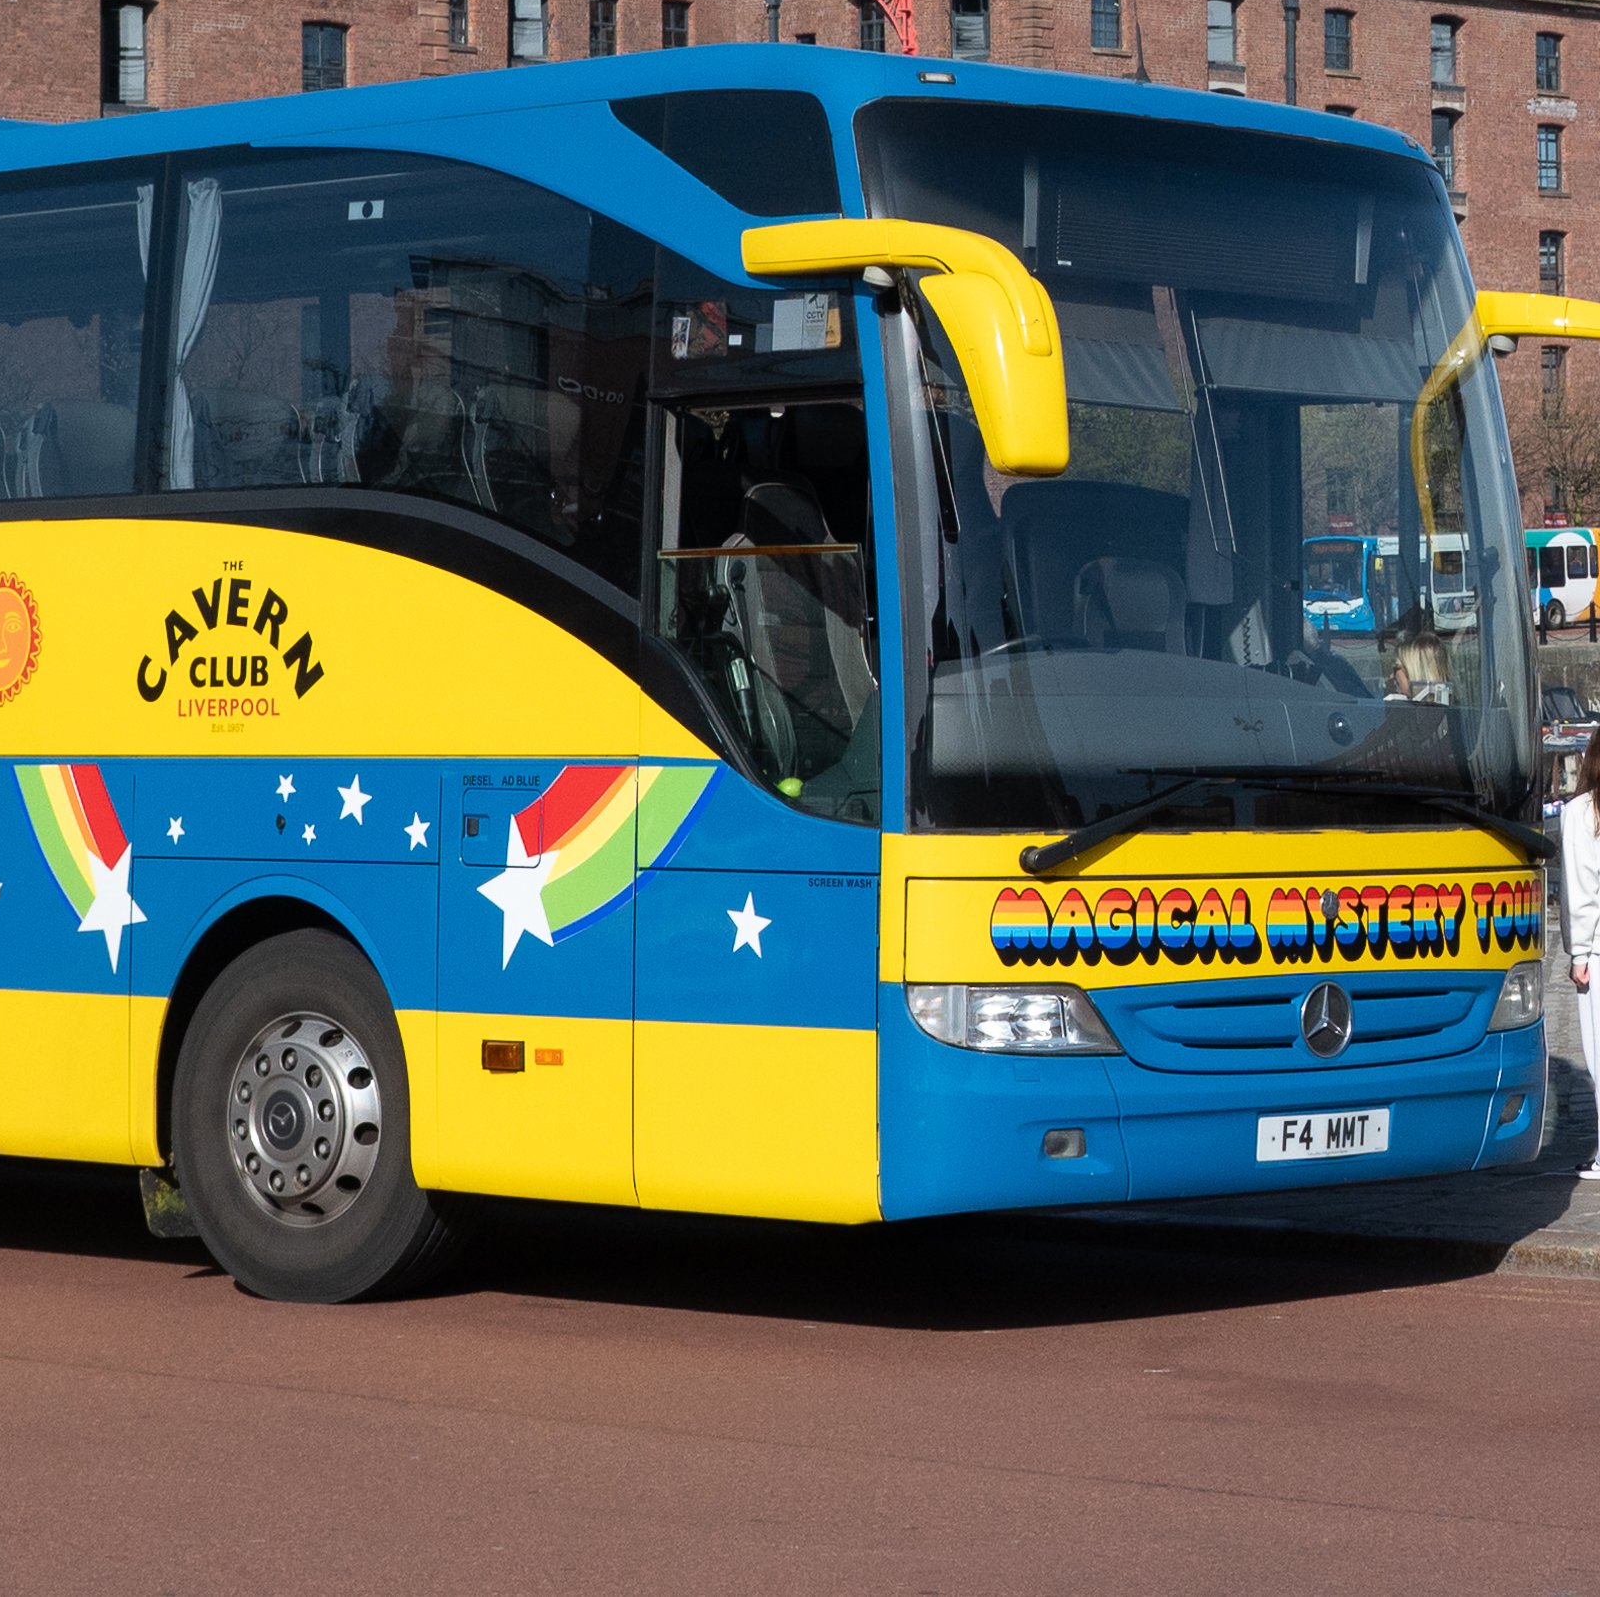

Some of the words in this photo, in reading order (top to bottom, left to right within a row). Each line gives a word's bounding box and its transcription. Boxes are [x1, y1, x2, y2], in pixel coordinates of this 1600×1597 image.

[806, 311, 825, 320] CCTV
[223, 560, 244, 571] THE
[137, 578, 325, 703] CAVERN
[189, 656, 269, 688] CLUB
[177, 698, 280, 717] LIVERPOOL
[227, 722, 245, 733] 1957
[462, 775, 494, 786] DIESEL
[516, 775, 540, 786] BLUE
[808, 878, 844, 888] SCREEN
[846, 878, 872, 888] WASH
[990, 888, 1261, 967] MAGICAL
[1266, 884, 1466, 963] MYSTERY
[1282, 1119, 1313, 1152] F4
[1326, 1114, 1369, 1149] MMT
